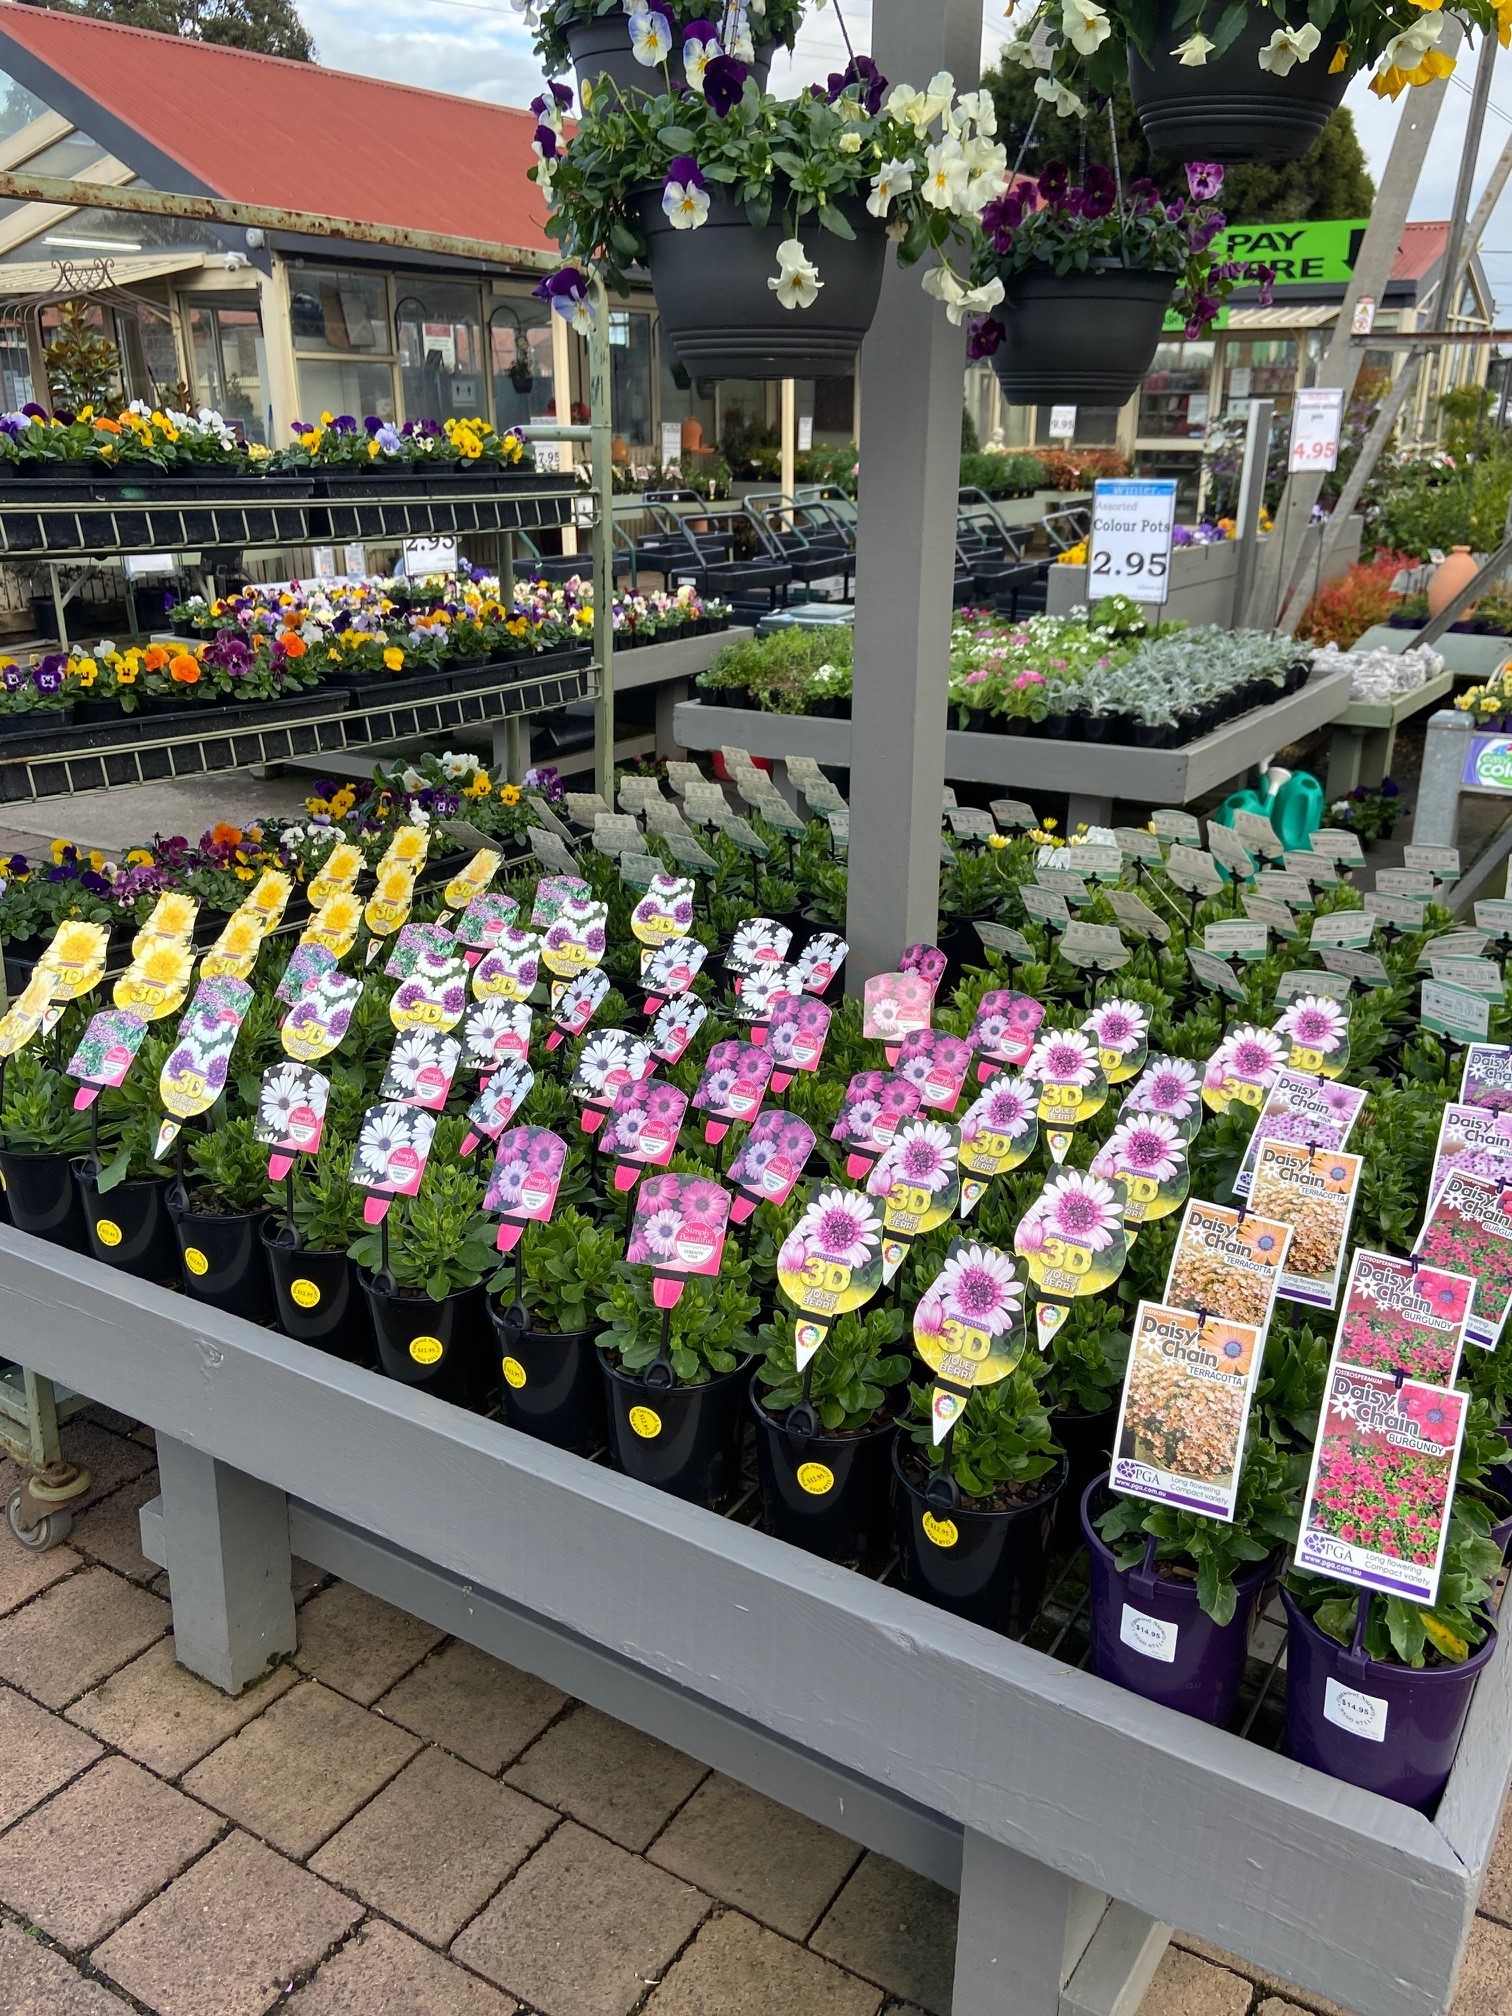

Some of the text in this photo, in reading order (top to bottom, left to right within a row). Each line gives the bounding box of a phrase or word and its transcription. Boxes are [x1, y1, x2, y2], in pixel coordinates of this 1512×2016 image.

[1226, 230, 1307, 254] PAY
[1211, 257, 1325, 280] ERE
[1293, 442, 1335, 459] 4.95
[1095, 502, 1138, 511] Assorted
[1093, 518, 1171, 533] Colour Pots
[1093, 550, 1168, 577] 2.95
[1479, 762, 1512, 778] col
[644, 914, 675, 933] 3D
[556, 940, 586, 962] 3D
[486, 972, 517, 995] 3D
[130, 982, 165, 1006] 3D
[405, 999, 443, 1024] 3D
[295, 1019, 326, 1045] 3D
[798, 1034, 814, 1045] Simply
[1008, 1028, 1025, 1040] Simply
[1288, 1044, 1324, 1071] 3D
[1471, 1053, 1510, 1070] Daisy
[423, 1069, 440, 1080] Simply
[928, 1076, 954, 1088] Beautiful
[932, 1070, 950, 1082] Simply
[1485, 1068, 1512, 1081] Cha
[174, 1069, 205, 1099] 3D
[736, 1082, 754, 1093] Simply
[1219, 1077, 1263, 1106] 3D
[1278, 1077, 1319, 1099] Daisy
[731, 1088, 757, 1099] Beautiful
[1041, 1083, 1083, 1107] 3D
[1046, 1106, 1077, 1115] VIOLET
[1290, 1095, 1329, 1114] Chain
[295, 1108, 313, 1121] Simply
[880, 1115, 899, 1125] Simp
[1046, 1112, 1076, 1121] BERRY
[1317, 1115, 1332, 1124] PINK
[1448, 1113, 1494, 1133] Daisy
[642, 1129, 670, 1140] Beautiful
[647, 1122, 667, 1134] Simply
[970, 1130, 1012, 1158] 3D
[1464, 1129, 1511, 1147] Chain
[391, 1157, 418, 1168] Beautiful
[395, 1150, 415, 1161] Simply
[773, 1157, 790, 1170] Simply
[973, 1154, 1000, 1165] VIOLET
[1262, 1149, 1310, 1171] Daisy
[971, 1160, 998, 1171] BERRY
[524, 1181, 550, 1192] Beautiful
[528, 1175, 547, 1186] Simply
[1113, 1171, 1159, 1202] 3D
[1278, 1167, 1325, 1188] Chain
[1454, 1173, 1490, 1189] OSTEOSPERMUM
[887, 1183, 932, 1215] 3D
[1301, 1187, 1345, 1202] TERRACOTTA
[1449, 1179, 1497, 1207] Daisy
[891, 1210, 921, 1223] VIOLET
[1461, 1199, 1510, 1227] Chain
[684, 1225, 710, 1240] Simply
[888, 1219, 918, 1231] BERRY
[1188, 1211, 1238, 1239] Daisy
[679, 1233, 714, 1246] Beautiful
[1204, 1232, 1253, 1258] Chain
[1039, 1237, 1092, 1275] 3D
[1226, 1256, 1272, 1274] TERRACOTTA
[1360, 1254, 1402, 1270] OSTEOSPERMUM
[800, 1257, 851, 1293] 3D
[1044, 1267, 1080, 1283] VIOLET
[1284, 1275, 1326, 1289] Long flowering
[1357, 1262, 1413, 1292] Daisy
[1042, 1277, 1078, 1292] BERRY
[1283, 1280, 1331, 1297] Compact variety
[802, 1297, 837, 1311] BERRY
[804, 1287, 839, 1303] VIOLET
[1376, 1284, 1432, 1314] Chain
[1144, 1308, 1186, 1321] OSTEOSPERMUM
[1404, 1311, 1453, 1331] BURGUNDY
[1141, 1316, 1199, 1347] Daisy
[1474, 1324, 1494, 1337] variety
[937, 1319, 992, 1361] 3D
[942, 1353, 978, 1372] VIOLET
[1161, 1339, 1218, 1368] Chain
[939, 1362, 975, 1380] BERRY
[1189, 1365, 1243, 1386] TERRACOTTA
[1335, 1368, 1383, 1385] OSTEOSPERMUM
[1333, 1377, 1397, 1411] Daisy
[1355, 1403, 1420, 1435] Chain
[1388, 1433, 1444, 1455] BURGUNDY
[807, 1473, 825, 1484] $12.95
[1135, 1467, 1160, 1486] PGA
[1170, 1475, 1221, 1496] Long flowering
[1115, 1478, 1167, 1497] www.pga.com.au
[1170, 1483, 1229, 1506] Compact variety
[930, 1523, 949, 1537] $12.95
[1325, 1544, 1354, 1563] PGA
[1304, 1553, 1362, 1576] www.pga.com.au
[1366, 1552, 1422, 1576] Long flowering
[1365, 1560, 1430, 1587] Compact variety
[1136, 1624, 1161, 1639] $14.95
[1153, 1621, 1167, 1640] Nursery
[1341, 1699, 1370, 1715] $14.95
[1361, 1695, 1376, 1717] Nursery
